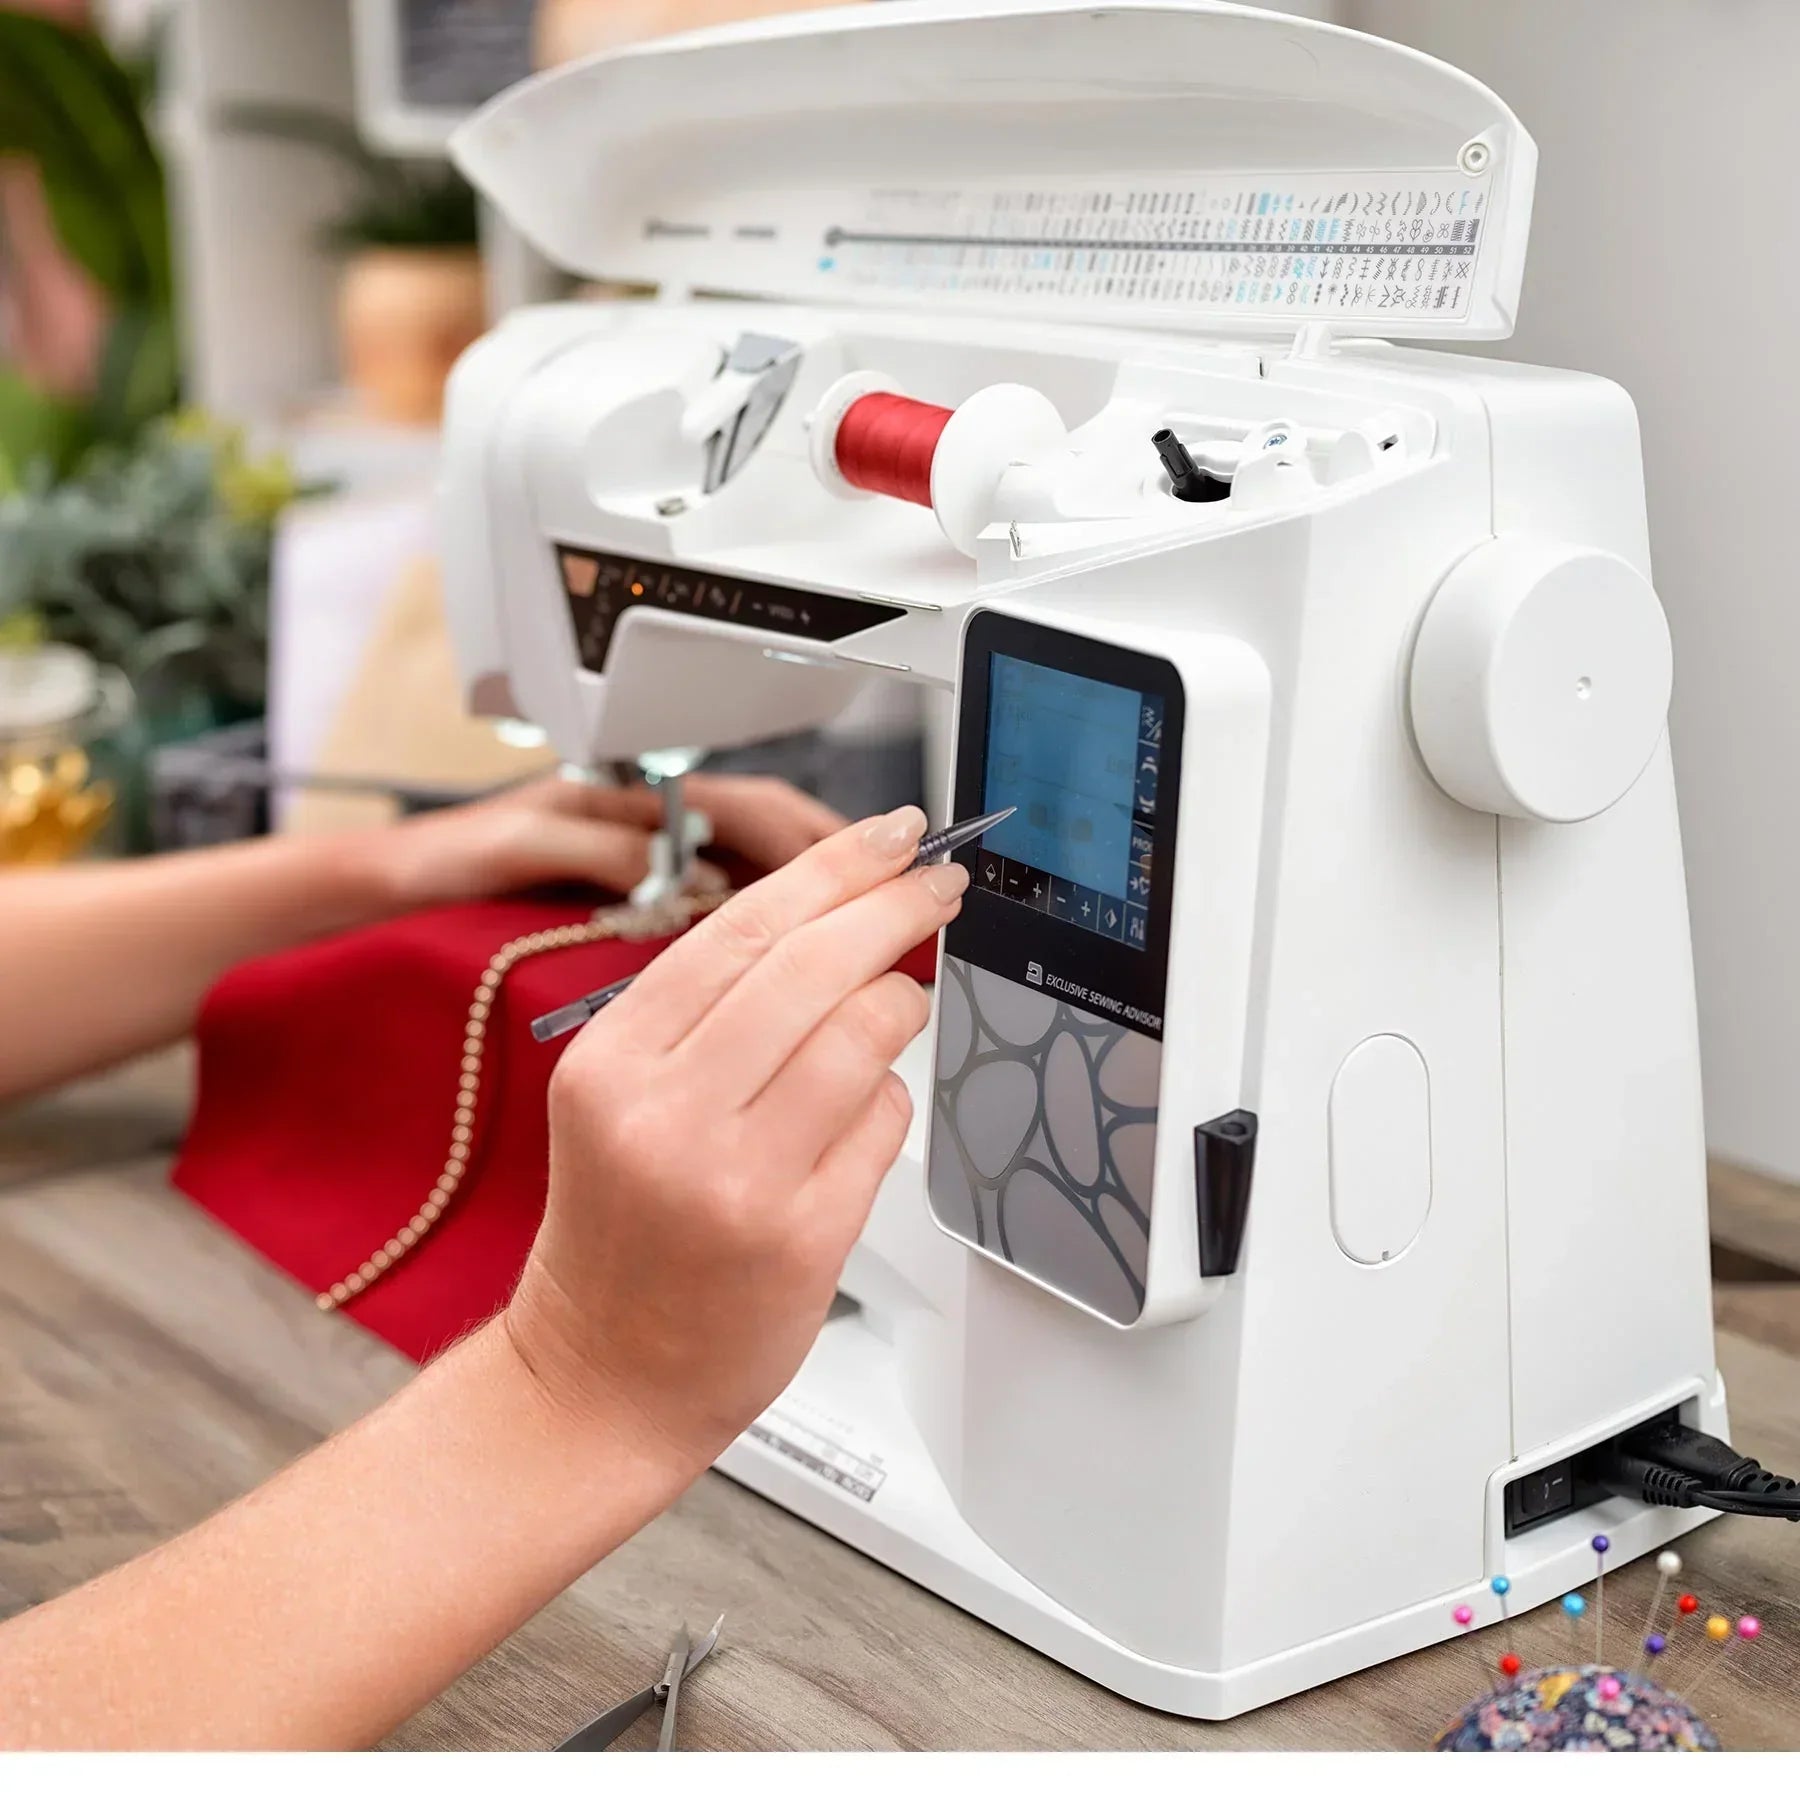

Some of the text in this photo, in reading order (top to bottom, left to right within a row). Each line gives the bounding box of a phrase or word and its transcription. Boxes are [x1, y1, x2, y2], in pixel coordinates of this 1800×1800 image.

[1420, 246, 1429, 254] 49
[1045, 973, 1163, 1031] EXCLUSIVE SEWING ADVISOR
